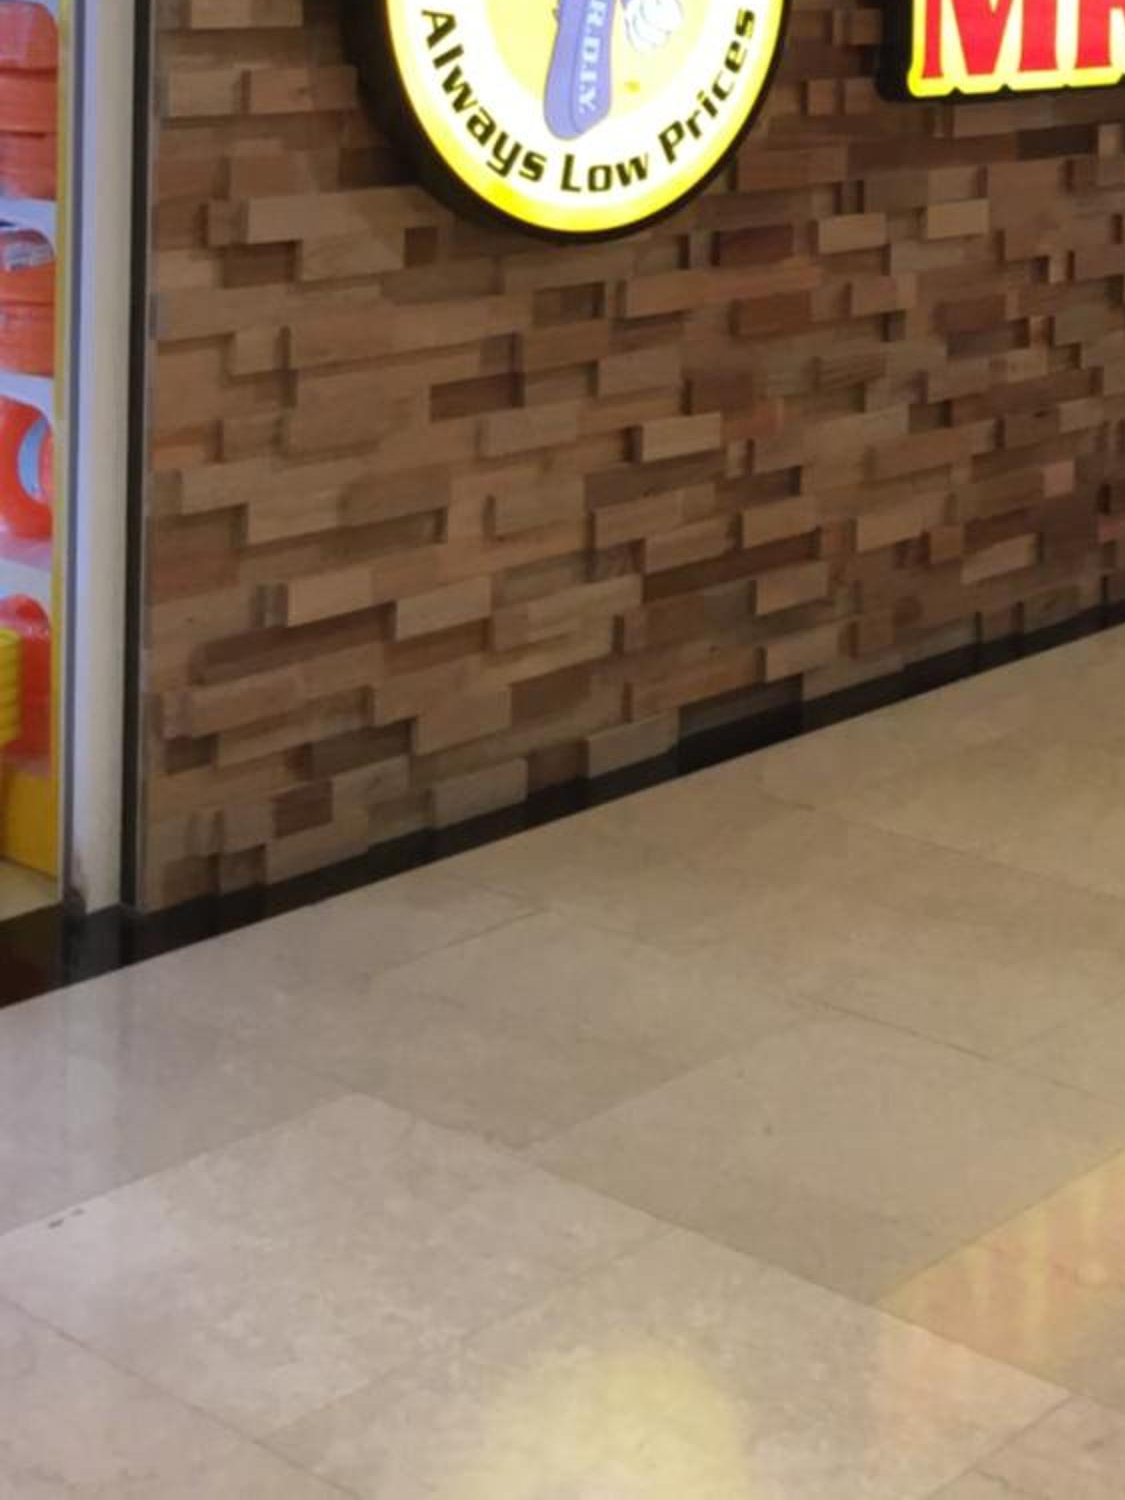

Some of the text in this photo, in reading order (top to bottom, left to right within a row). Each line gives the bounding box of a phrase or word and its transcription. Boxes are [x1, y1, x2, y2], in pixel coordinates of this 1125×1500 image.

[420, 7, 756, 193] Always Low Prices
